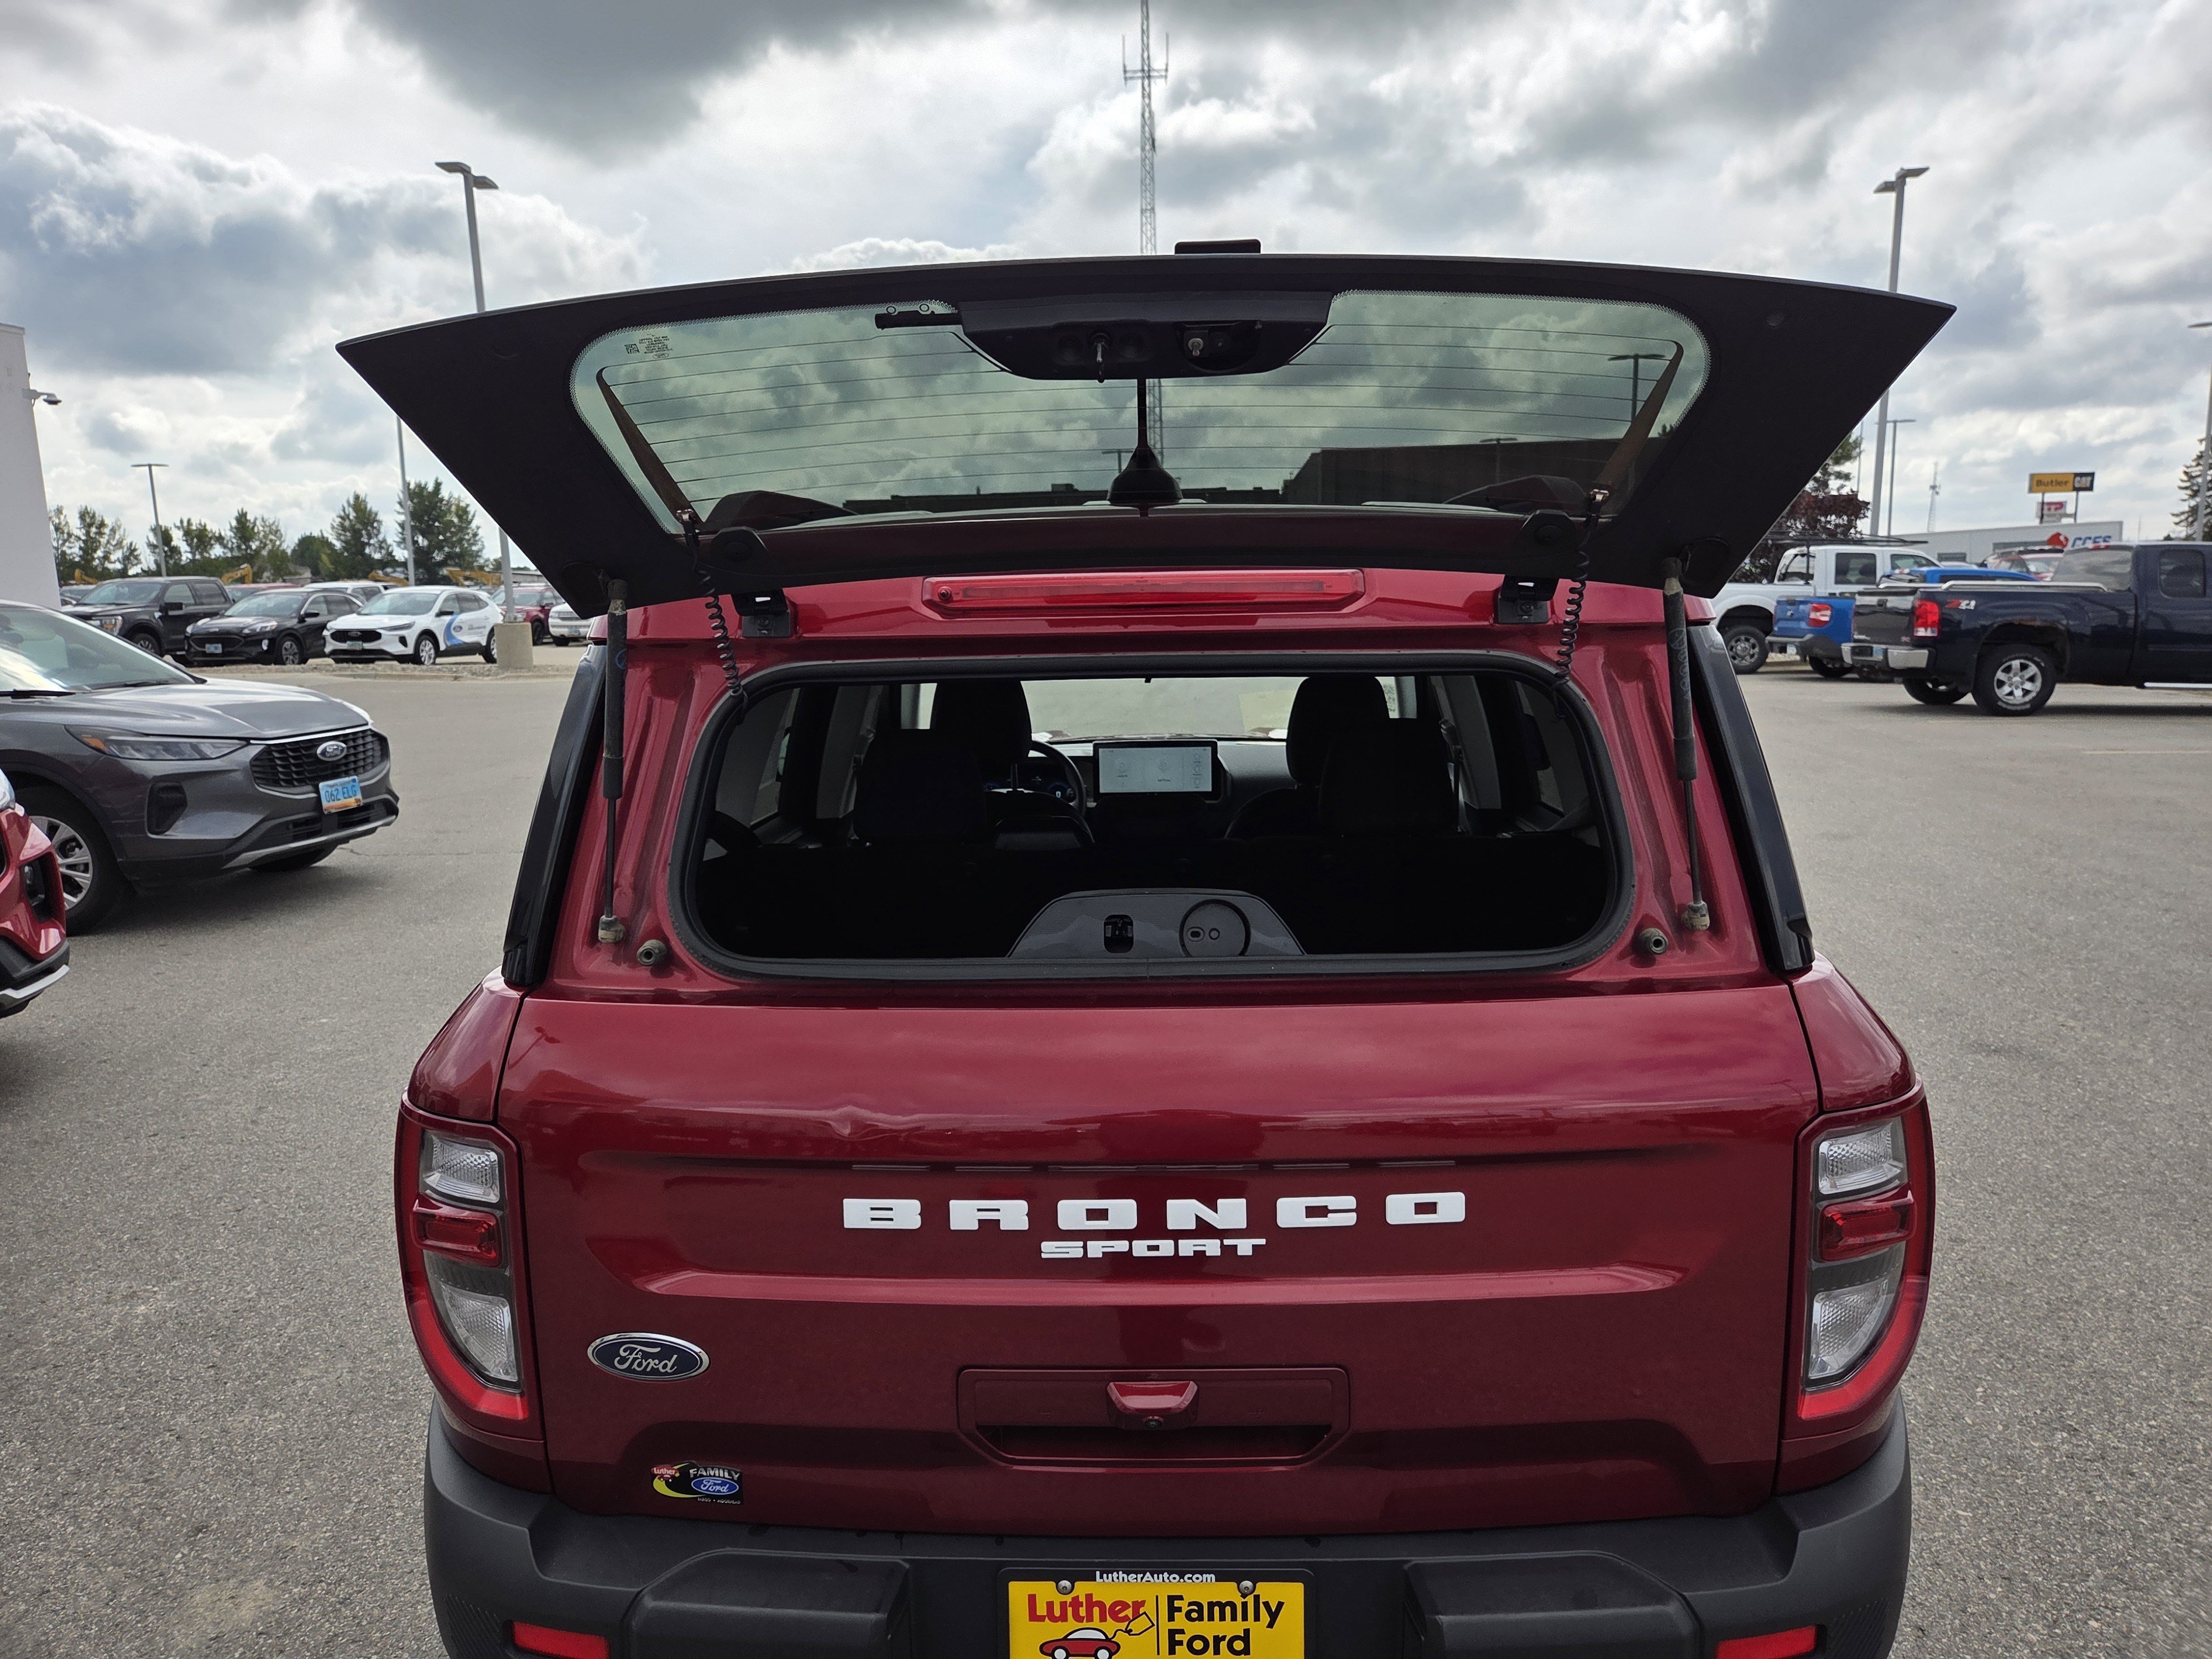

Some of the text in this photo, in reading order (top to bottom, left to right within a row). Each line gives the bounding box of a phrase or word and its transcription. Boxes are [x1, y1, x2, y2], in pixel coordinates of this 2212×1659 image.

[2036, 476, 2092, 488] Butler CAT
[843, 1192, 1465, 1230] BRONCO
[1041, 1239, 1266, 1258] SPORT
[614, 1344, 678, 1373] Ford
[653, 1467, 676, 1475] Luther
[689, 1468, 740, 1480] FAMILY
[701, 1479, 729, 1493] Ford
[1095, 1571, 1215, 1584] LutherAuto.com
[1027, 1593, 1146, 1624] Luther
[1167, 1594, 1285, 1629] Family
[1168, 1627, 1251, 1656] Ford
